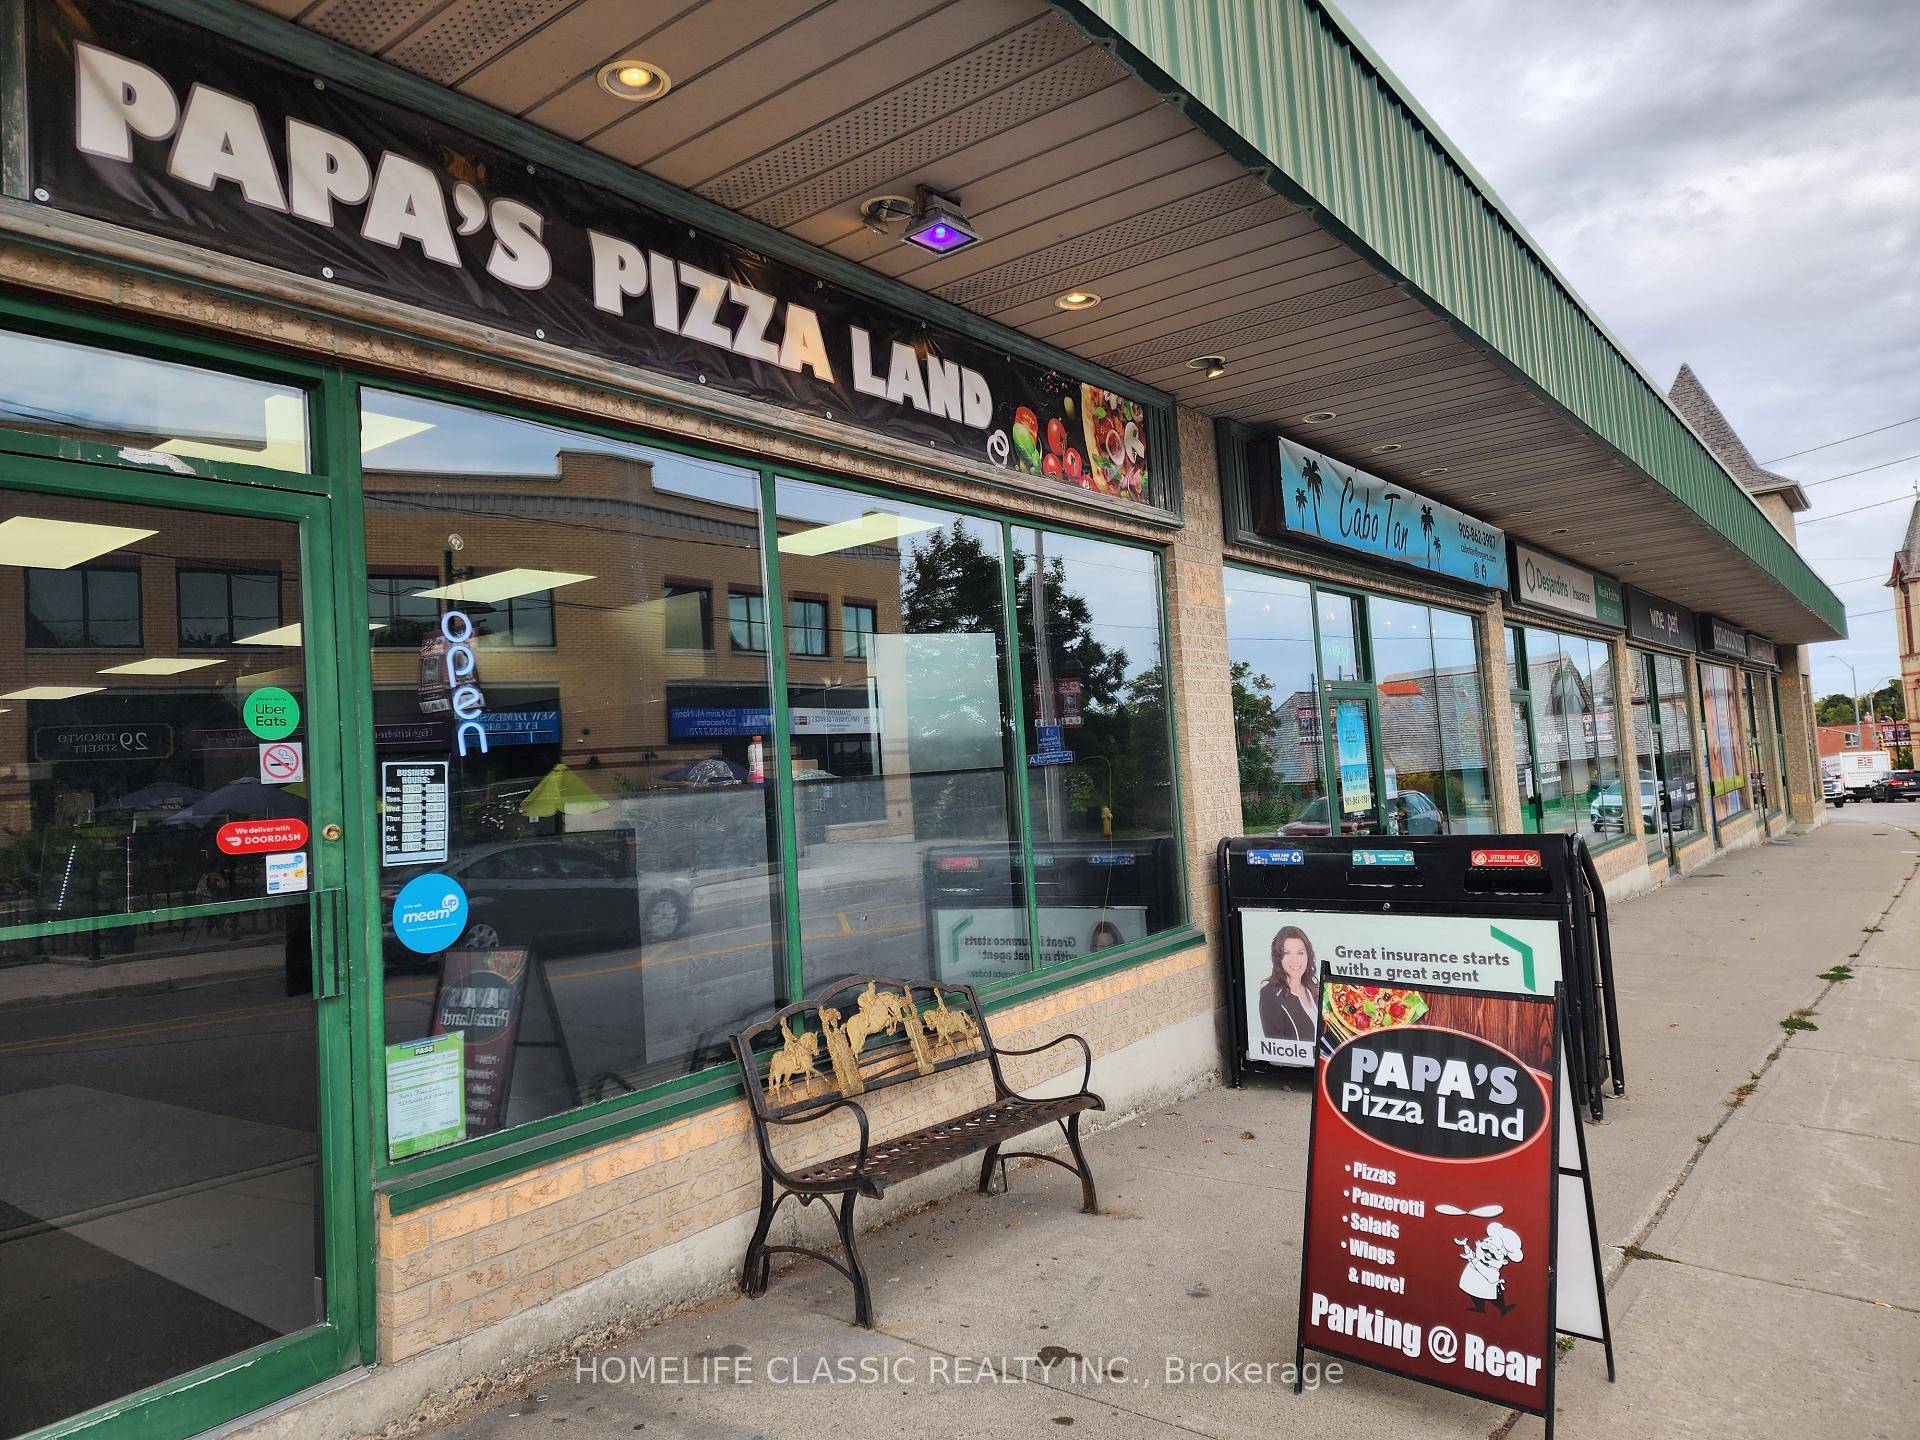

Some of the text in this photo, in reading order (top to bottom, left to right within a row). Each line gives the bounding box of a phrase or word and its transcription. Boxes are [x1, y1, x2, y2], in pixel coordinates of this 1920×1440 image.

[74, 39, 994, 430] PAPA'S PIZZA LAND
[1339, 476, 1409, 556] Cabo Tan
[1536, 567, 1590, 603] Desjardins Insurance
[441, 610, 488, 756] open
[256, 704, 287, 714] Uber
[256, 716, 287, 726] Eats
[396, 768, 435, 776] BUSINESS
[402, 776, 430, 784] HOURS:
[244, 834, 301, 845] DOORDASH
[249, 826, 274, 834] deliver
[402, 908, 450, 924] meem
[1335, 945, 1510, 966] Great insurance starts
[1336, 962, 1479, 984] with a great agent
[415, 1045, 434, 1055] PASS
[1260, 1041, 1308, 1059] Nicole
[1350, 1048, 1518, 1105] PAPA'S
[1342, 1082, 1524, 1142] Pizza Land
[1352, 1161, 1396, 1186] Pizzas
[1352, 1186, 1425, 1218] Panzerotti
[1350, 1212, 1400, 1240] Salads
[1349, 1238, 1396, 1265] Wings
[1348, 1267, 1406, 1295] & more!
[1310, 1292, 1542, 1387] Parking @ Rear
